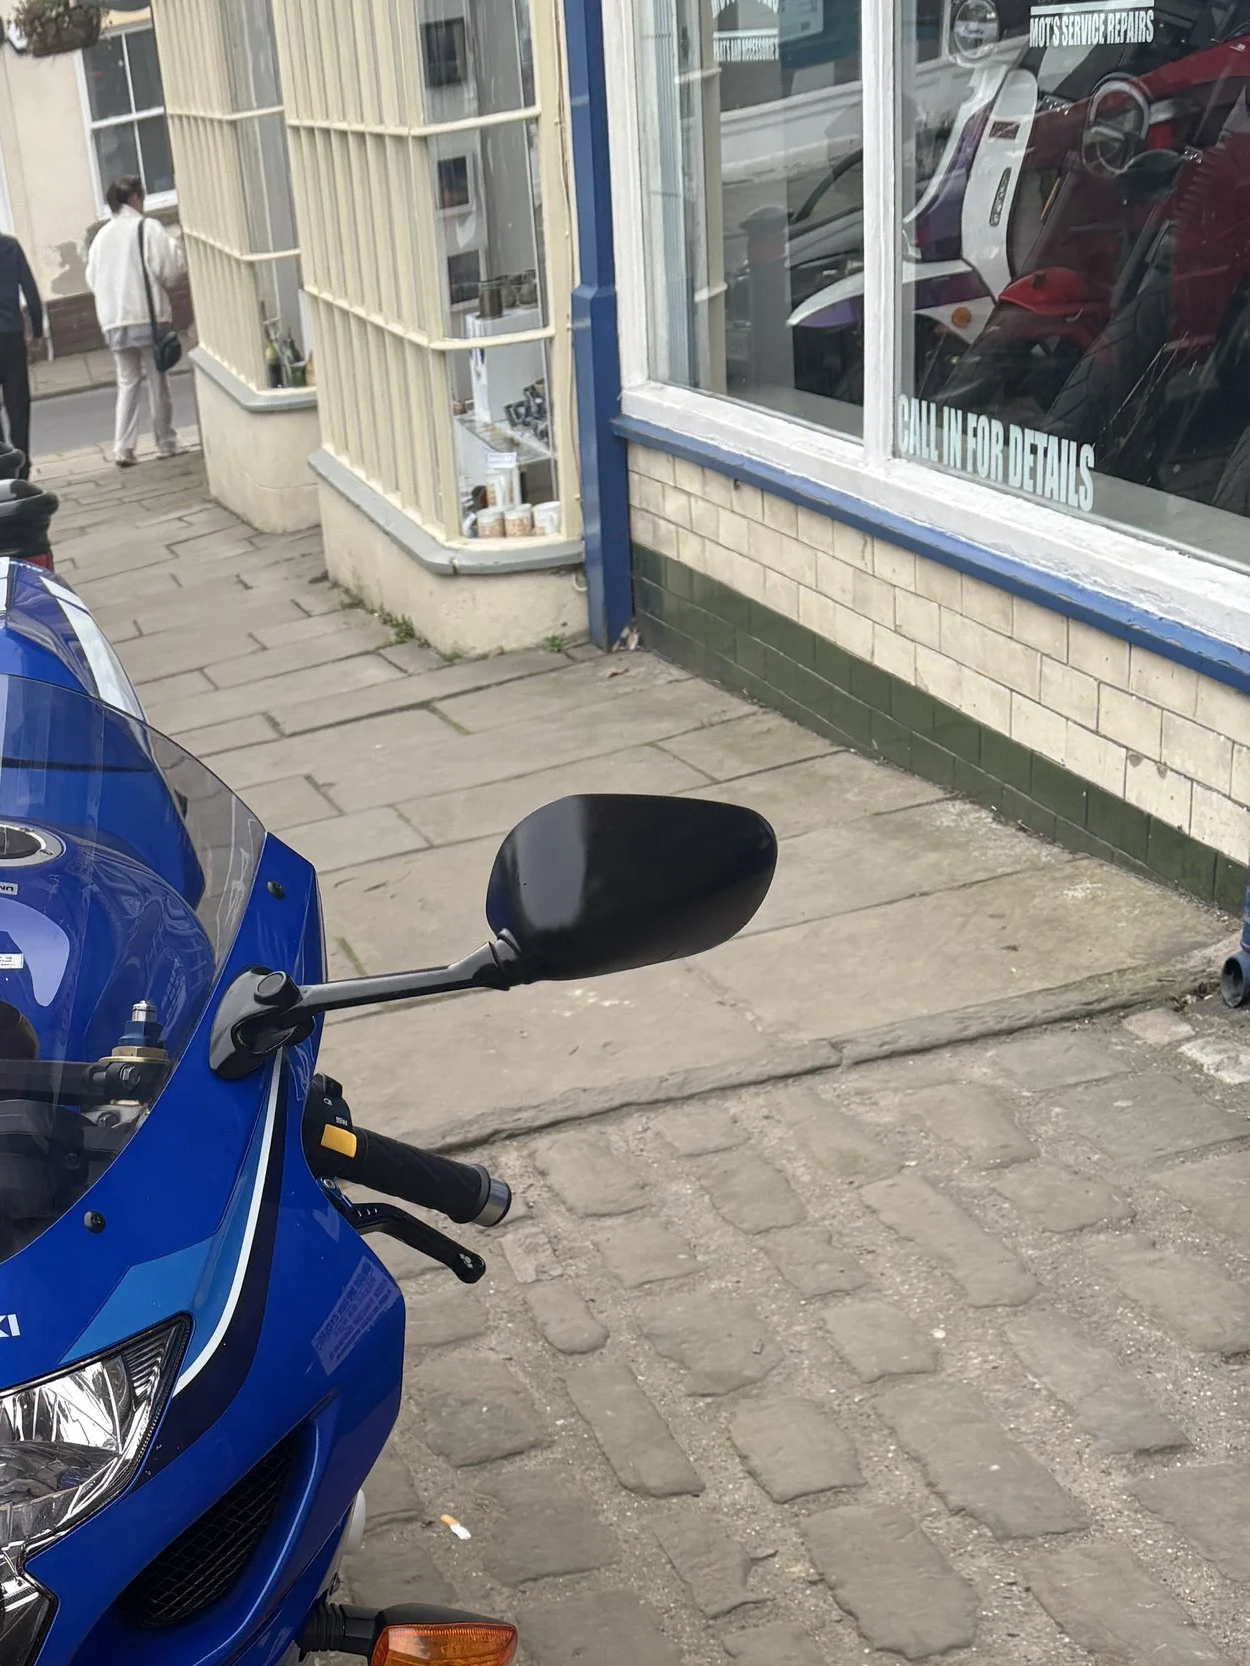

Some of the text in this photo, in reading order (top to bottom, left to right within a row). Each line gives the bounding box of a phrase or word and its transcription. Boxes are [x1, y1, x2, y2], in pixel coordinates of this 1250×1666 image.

[1030, 9, 1154, 47] MOT'S SERVICE REPAIRS
[897, 394, 1095, 512] CALL IN FOR DETAILS
